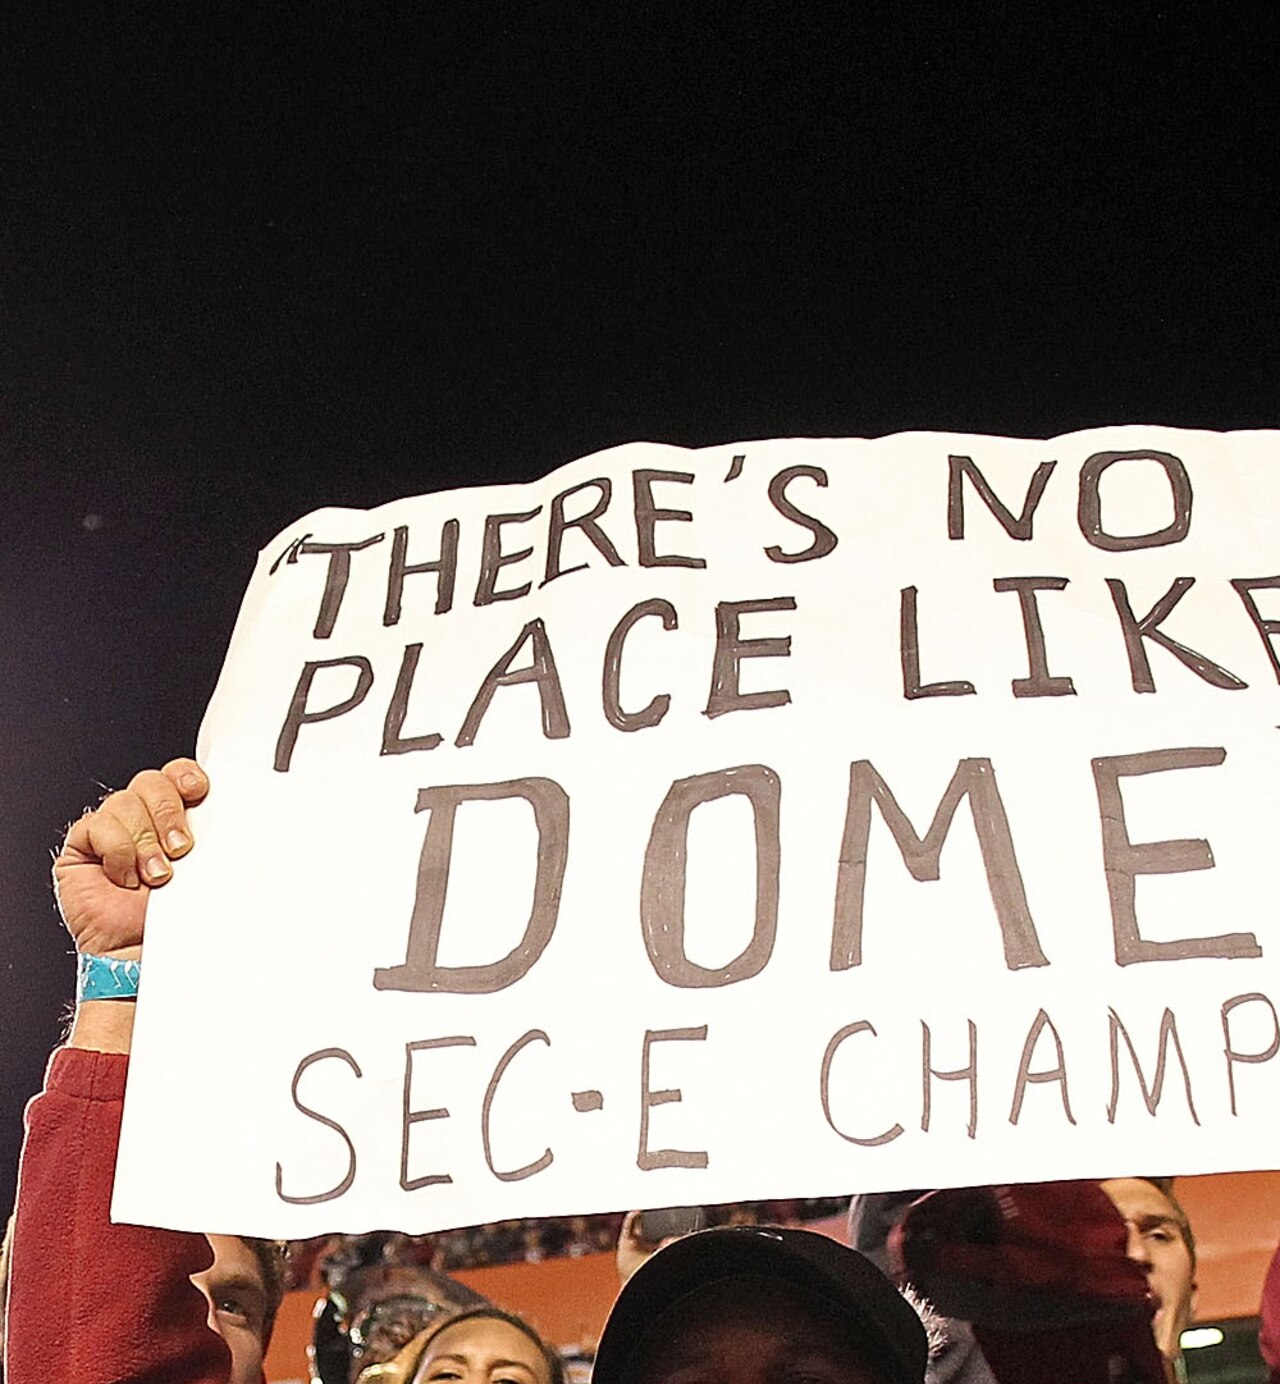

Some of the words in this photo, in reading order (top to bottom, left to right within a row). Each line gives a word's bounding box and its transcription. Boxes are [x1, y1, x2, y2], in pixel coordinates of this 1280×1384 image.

[269, 454, 838, 639] "THERE'S
[947, 449, 1193, 552] NO
[273, 596, 798, 773] PLACE
